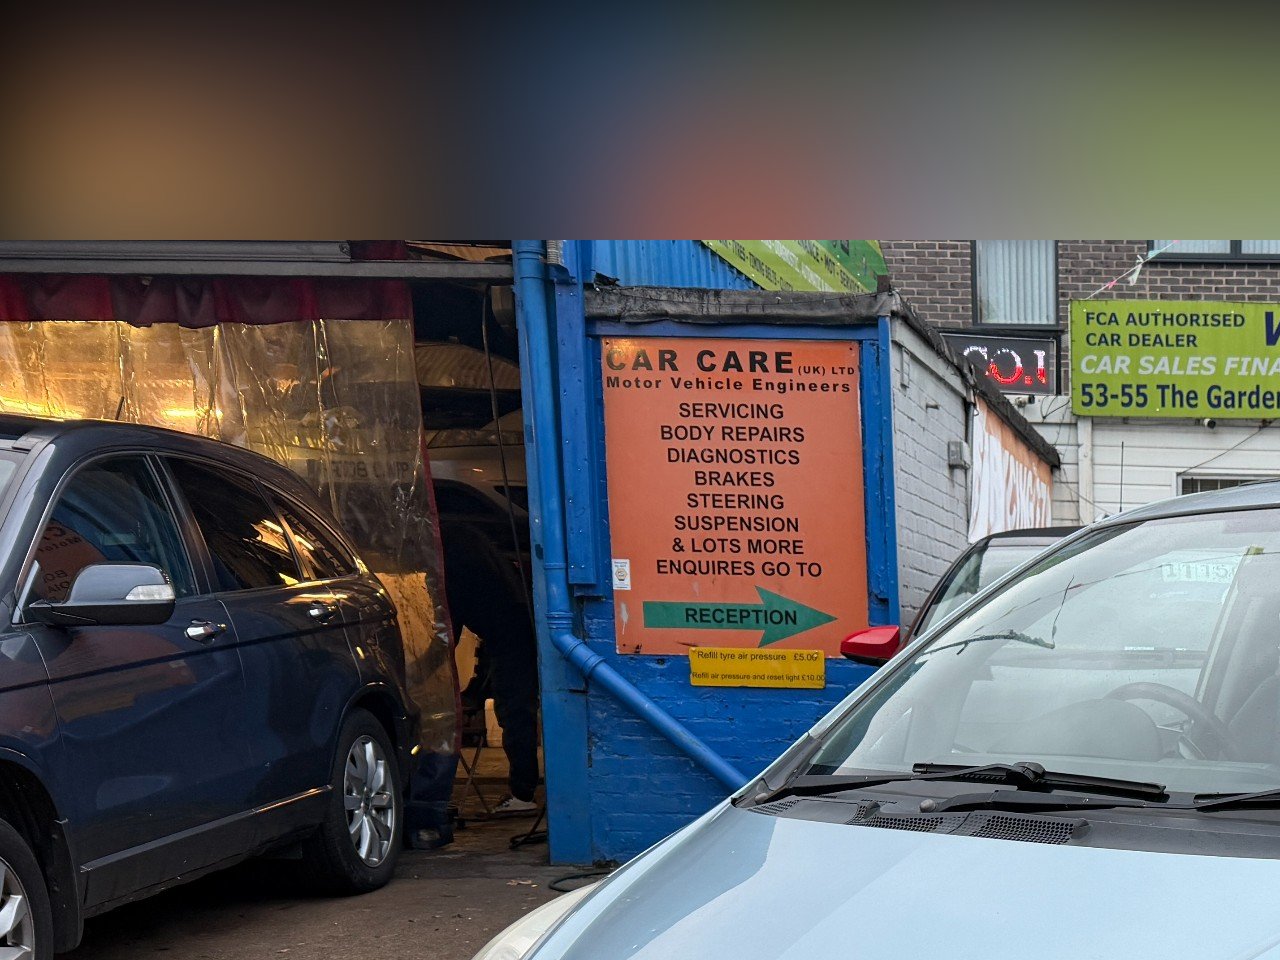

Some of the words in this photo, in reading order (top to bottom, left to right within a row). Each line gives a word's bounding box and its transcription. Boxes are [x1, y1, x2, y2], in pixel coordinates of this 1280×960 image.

[1085, 312, 1118, 326] FCA
[1125, 312, 1245, 328] AUTHORISED
[1085, 333, 1125, 347] CAR
[1128, 333, 1198, 348] DEALER
[606, 349, 679, 372] CAR
[696, 351, 794, 374] CARE
[797, 365, 826, 377] (UK)
[831, 366, 856, 376] LTD
[1080, 356, 1132, 374] CAR
[1138, 356, 1216, 376] SALES
[606, 376, 662, 390] Motor
[670, 377, 743, 391] Vehicle
[752, 378, 852, 394] Engineers
[1080, 383, 1149, 409] 53-55
[1156, 384, 1199, 409] The
[678, 402, 785, 420] SERVICING
[660, 425, 715, 441] BODY
[721, 426, 806, 443] REPAIRS
[667, 448, 800, 465] DIAGNOSTICS
[694, 471, 775, 487] BRAKES
[686, 493, 785, 510] STEERING
[674, 515, 799, 533] SUSPENSION
[672, 538, 686, 553] &
[691, 538, 741, 554] LOTS
[747, 539, 804, 555] MORE
[656, 559, 755, 577] ENQUIRES
[760, 560, 791, 577] GO
[796, 561, 822, 578] TO
[685, 607, 798, 626] RECEPTION
[697, 650, 718, 660] Refill
[720, 652, 736, 662] tyre
[737, 651, 748, 660] air
[750, 652, 787, 662] pressure
[692, 671, 710, 679] Refill
[721, 673, 751, 681] pressure
